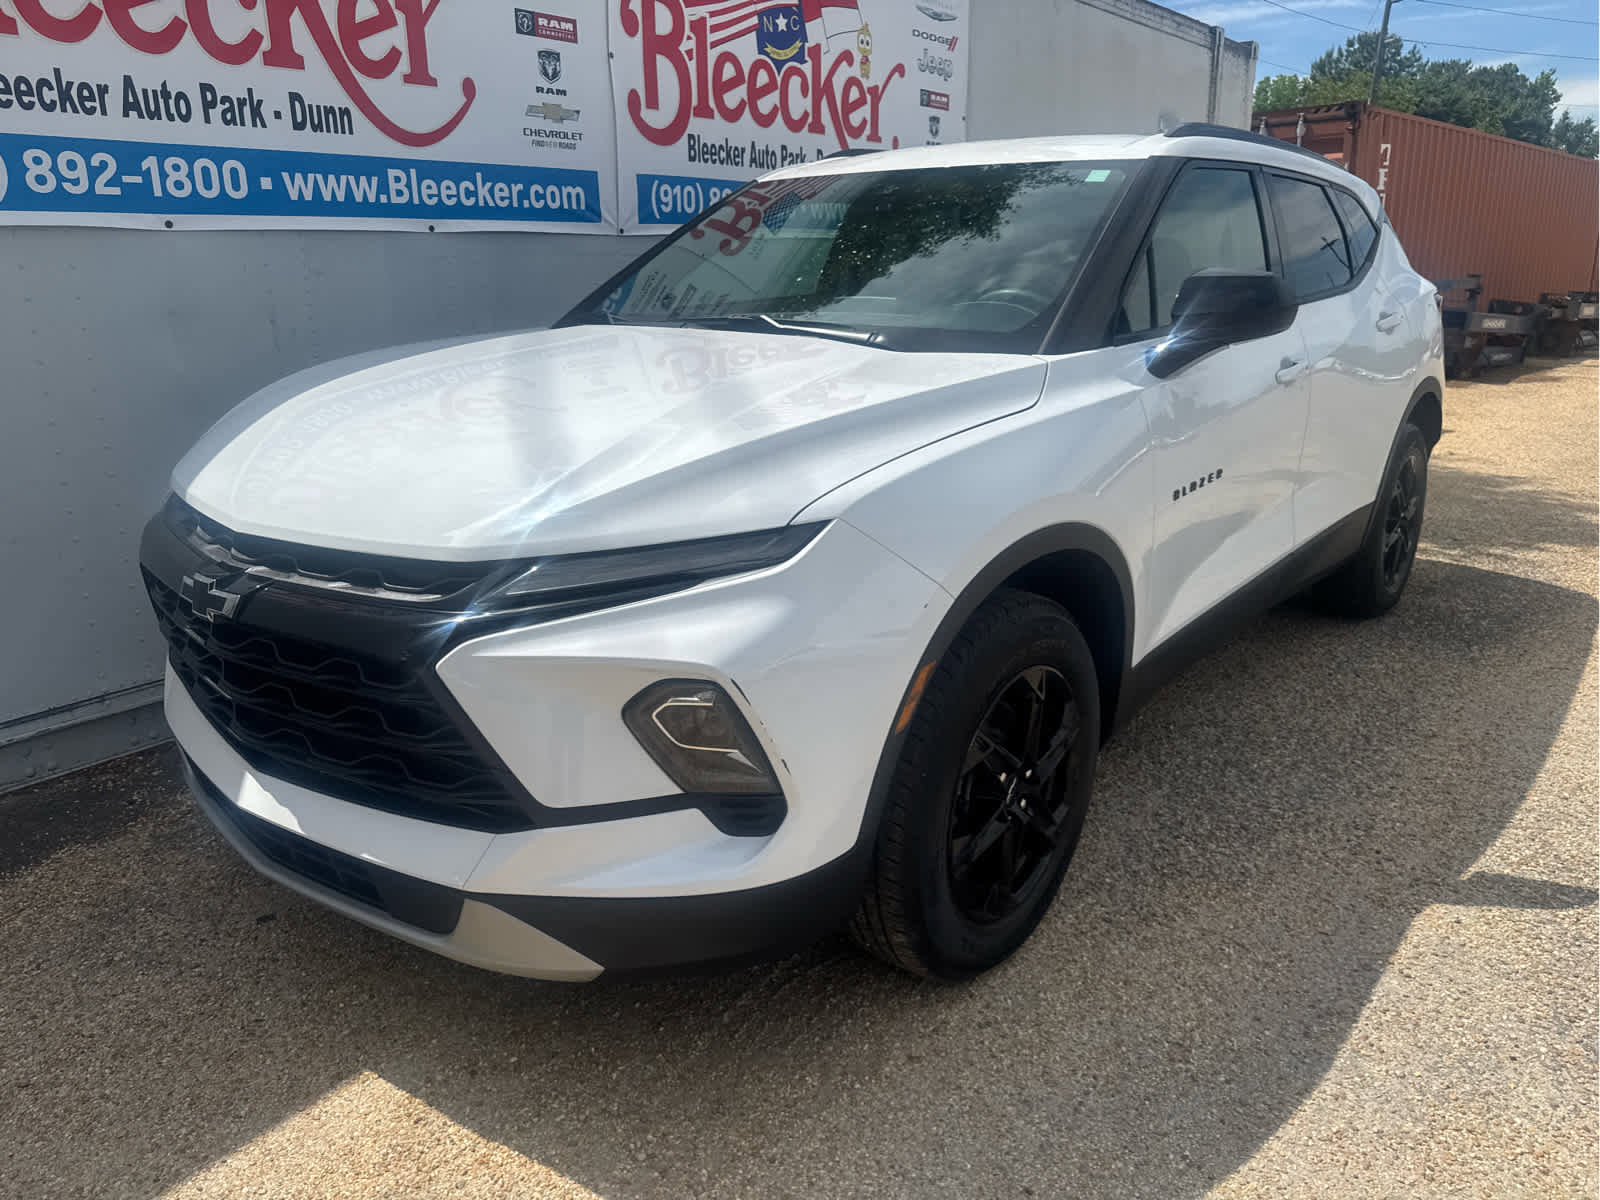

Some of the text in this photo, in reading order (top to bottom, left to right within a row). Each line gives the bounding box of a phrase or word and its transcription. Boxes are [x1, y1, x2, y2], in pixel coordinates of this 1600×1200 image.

[538, 17, 574, 32] RAM
[763, 15, 800, 33] N C
[912, 28, 953, 46] DODGE
[619, 0, 905, 150] Bleecker
[917, 47, 953, 82] Jeep
[122, 74, 192, 123] Auto
[199, 82, 267, 129] Park
[288, 91, 354, 135] Dunn
[535, 85, 568, 97] RAM
[522, 127, 584, 141] CHEVROLET
[687, 132, 746, 168] Bleecker
[749, 140, 778, 170] Auto
[22, 148, 249, 200] 892-1800
[281, 168, 586, 211] www.Bleecker.com
[651, 179, 704, 219] (910)
[1172, 468, 1224, 502] BLAZER
